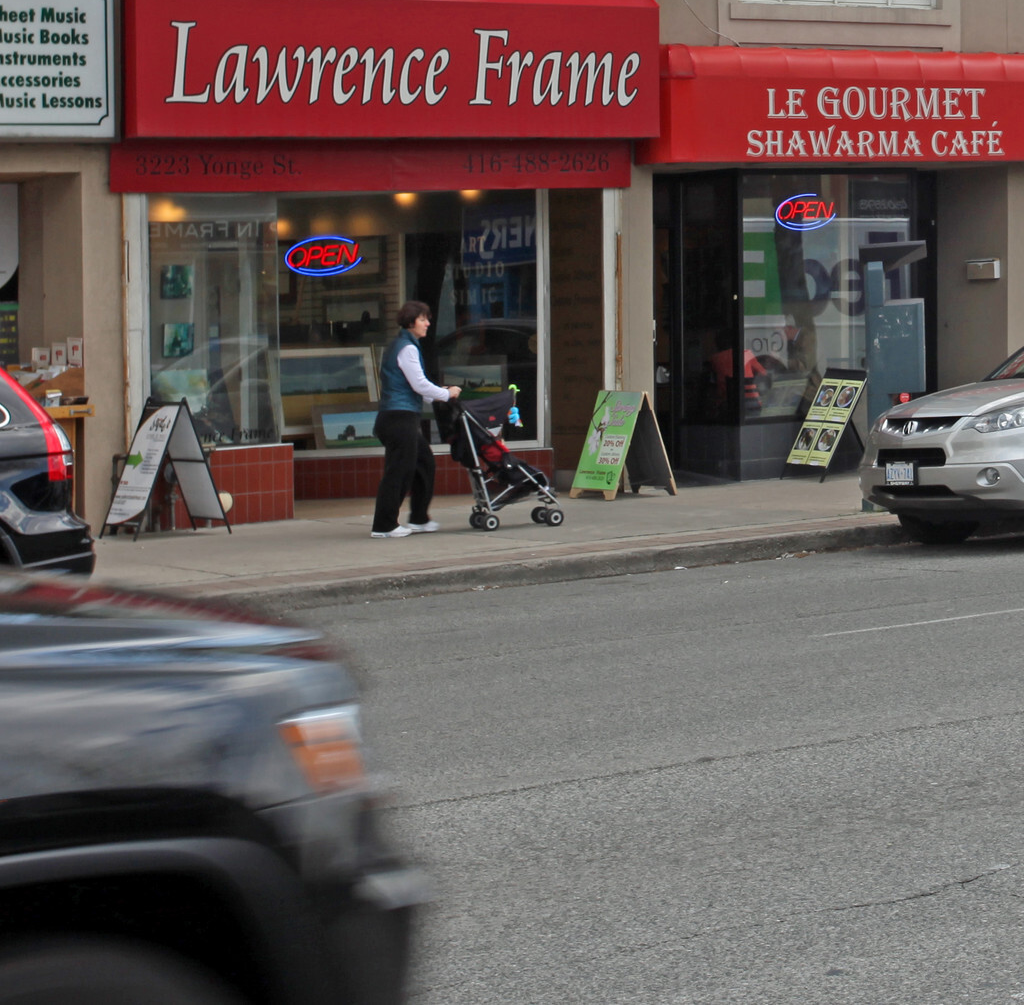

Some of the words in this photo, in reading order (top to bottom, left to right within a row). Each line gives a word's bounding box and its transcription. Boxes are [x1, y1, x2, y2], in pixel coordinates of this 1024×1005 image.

[41, 6, 87, 24] Music
[0, 28, 35, 44] usic
[40, 28, 89, 45] Books
[165, 20, 450, 106] Lawrence
[469, 28, 640, 107] Frame
[42, 92, 102, 109] Lessons
[766, 86, 809, 120] LE
[817, 85, 986, 123] GOURMET
[746, 125, 924, 158] SHAWARMA
[931, 120, 1005, 157] CAFÉ
[135, 154, 190, 175] 3223
[199, 154, 264, 180] Yonge
[272, 154, 302, 176] St.
[462, 152, 610, 175] 416-488-2626
[779, 200, 835, 220] OPEN
[287, 244, 358, 268] OPEN
